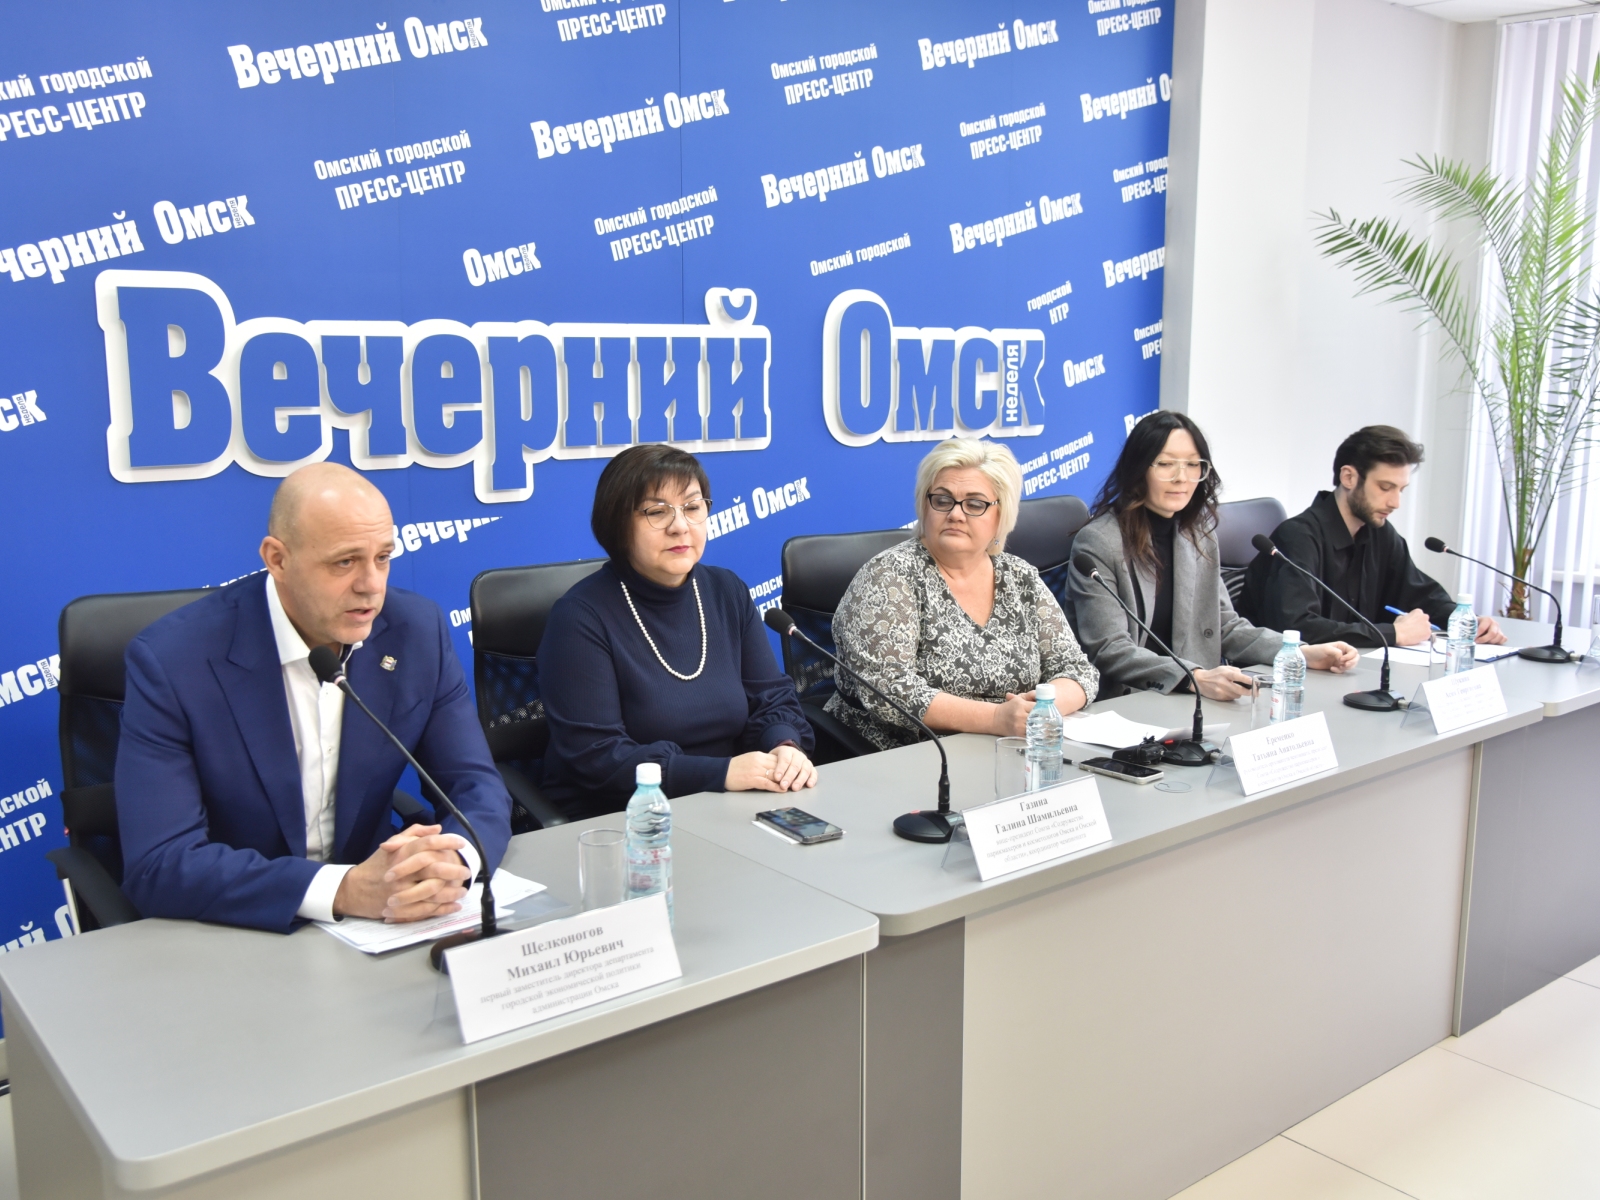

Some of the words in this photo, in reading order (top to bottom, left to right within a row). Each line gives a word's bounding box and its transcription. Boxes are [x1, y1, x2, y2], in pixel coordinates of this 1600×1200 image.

[557, 4, 666, 41] ПРЕСС-ЦЕНТР
[1097, 8, 1161, 36] ПРЕСС-ЦЕНТР
[227, 22, 401, 88] Вечерний
[404, 17, 488, 58] Омск
[771, 56, 817, 79] Омский
[819, 44, 877, 69] городской
[918, 23, 1011, 70] Вечерний
[1013, 19, 1058, 50] Омск
[40, 56, 152, 93] городской
[784, 68, 873, 105] ПРЕСС-ЦЕНТР
[960, 115, 997, 137] Омский
[999, 103, 1046, 127] городской
[1080, 78, 1157, 122] Вечерний
[530, 98, 664, 159] Вечерний
[664, 89, 729, 128] Омск
[970, 125, 1042, 159] ПРЕСС-ЦЕНТР
[314, 149, 382, 179] Омский
[386, 130, 471, 164] городской
[761, 151, 869, 208] Вечерний
[872, 144, 925, 178] Омск
[1113, 161, 1144, 183] Омский
[335, 161, 465, 210] ПРЕСС-ЦЕНТР
[154, 195, 255, 244] Омск
[594, 207, 647, 235] Омский
[650, 186, 718, 220] городской
[950, 201, 1037, 253] Вечерний
[1039, 193, 1083, 224] Омск
[610, 215, 714, 261] ПРЕСС-ЦЕНТР
[810, 250, 853, 276] Омский
[856, 233, 911, 262] городской
[463, 242, 541, 286] Омск
[1027, 281, 1072, 311] городской
[115, 284, 769, 493] Вечерний
[835, 298, 1044, 437] Омск
[1005, 344, 1019, 423] неделя
[1063, 354, 1105, 387] Омск
[1019, 452, 1049, 475] мский
[1050, 432, 1093, 461] городской
[1024, 453, 1090, 495] ПРЕСС-ЦЕНТР
[752, 477, 810, 518] Омск
[994, 819, 1026, 834] Галина
[1027, 804, 1078, 825] Шамильевна
[1019, 797, 1048, 812] Газина
[506, 958, 561, 982] Михаил
[564, 938, 625, 966] Юрьевич
[520, 925, 604, 958] Щелконогов
[479, 986, 512, 1004] первый
[512, 974, 562, 994] заместитель
[563, 961, 604, 980] директора
[603, 946, 655, 968] департамента
[500, 989, 544, 1011] городской
[544, 971, 604, 996] экономической
[593, 981, 620, 995] Омска
